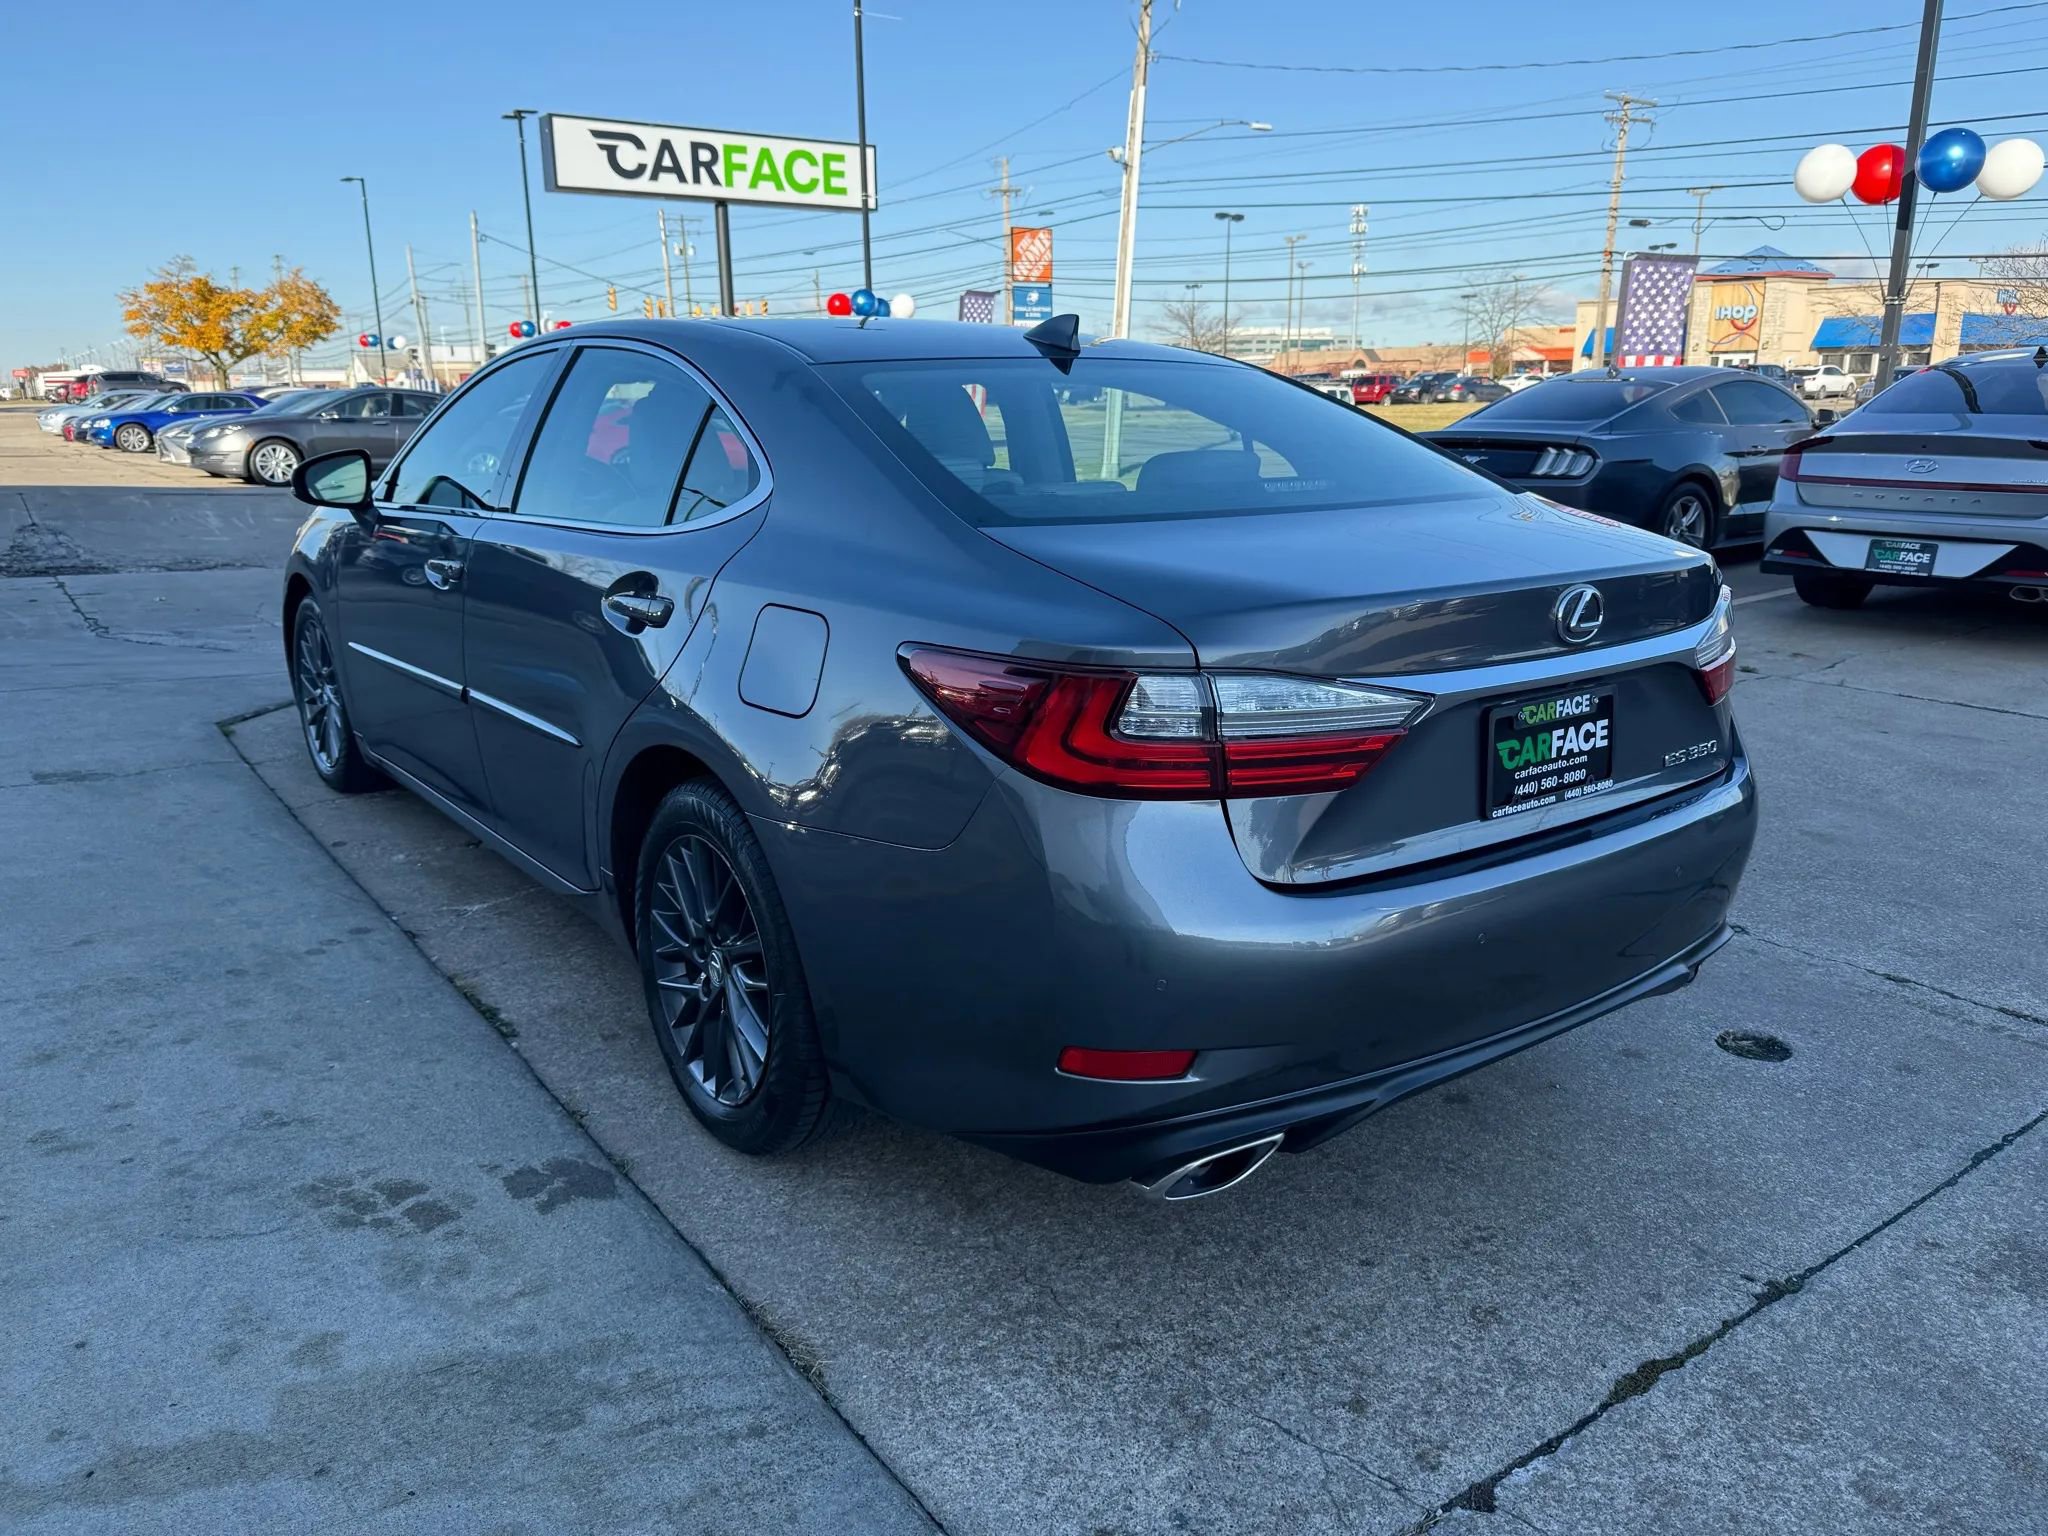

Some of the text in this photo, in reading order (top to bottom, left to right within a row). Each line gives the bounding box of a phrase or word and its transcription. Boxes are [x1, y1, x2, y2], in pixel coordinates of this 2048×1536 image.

[588, 128, 848, 196] CARFACE
[1854, 490, 1982, 505] SONATA
[1873, 549, 1931, 564] CARFACE
[1522, 694, 1591, 725] CARFACE
[1496, 719, 1609, 770] CARFACE
[1514, 755, 1588, 780] carfaceauto.com
[1492, 779, 1614, 818] carfaceauto.com (440) 560-8080
[1514, 780, 1538, 796] (440)
